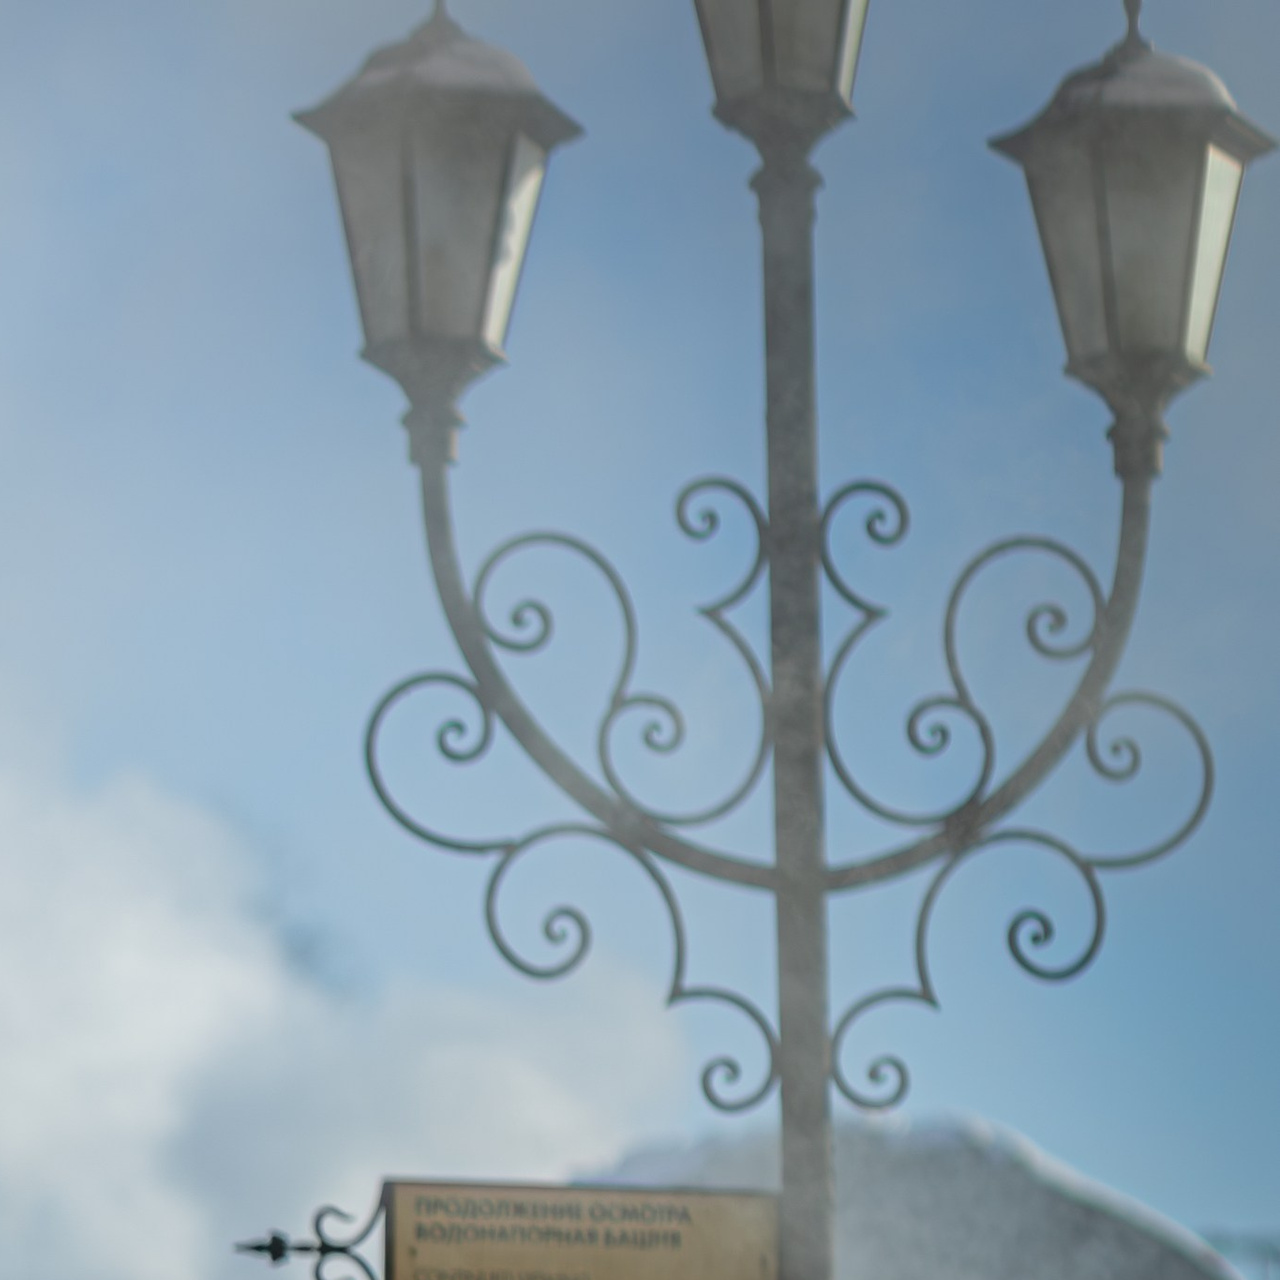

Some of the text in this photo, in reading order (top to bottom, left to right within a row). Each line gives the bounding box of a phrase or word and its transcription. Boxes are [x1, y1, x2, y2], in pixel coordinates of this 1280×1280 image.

[415, 1196, 693, 1225] ПРОДОЛЖЕНИЕ ОСМОТРА
[415, 1221, 598, 1247] ВОДОНАПОРНАЯ
